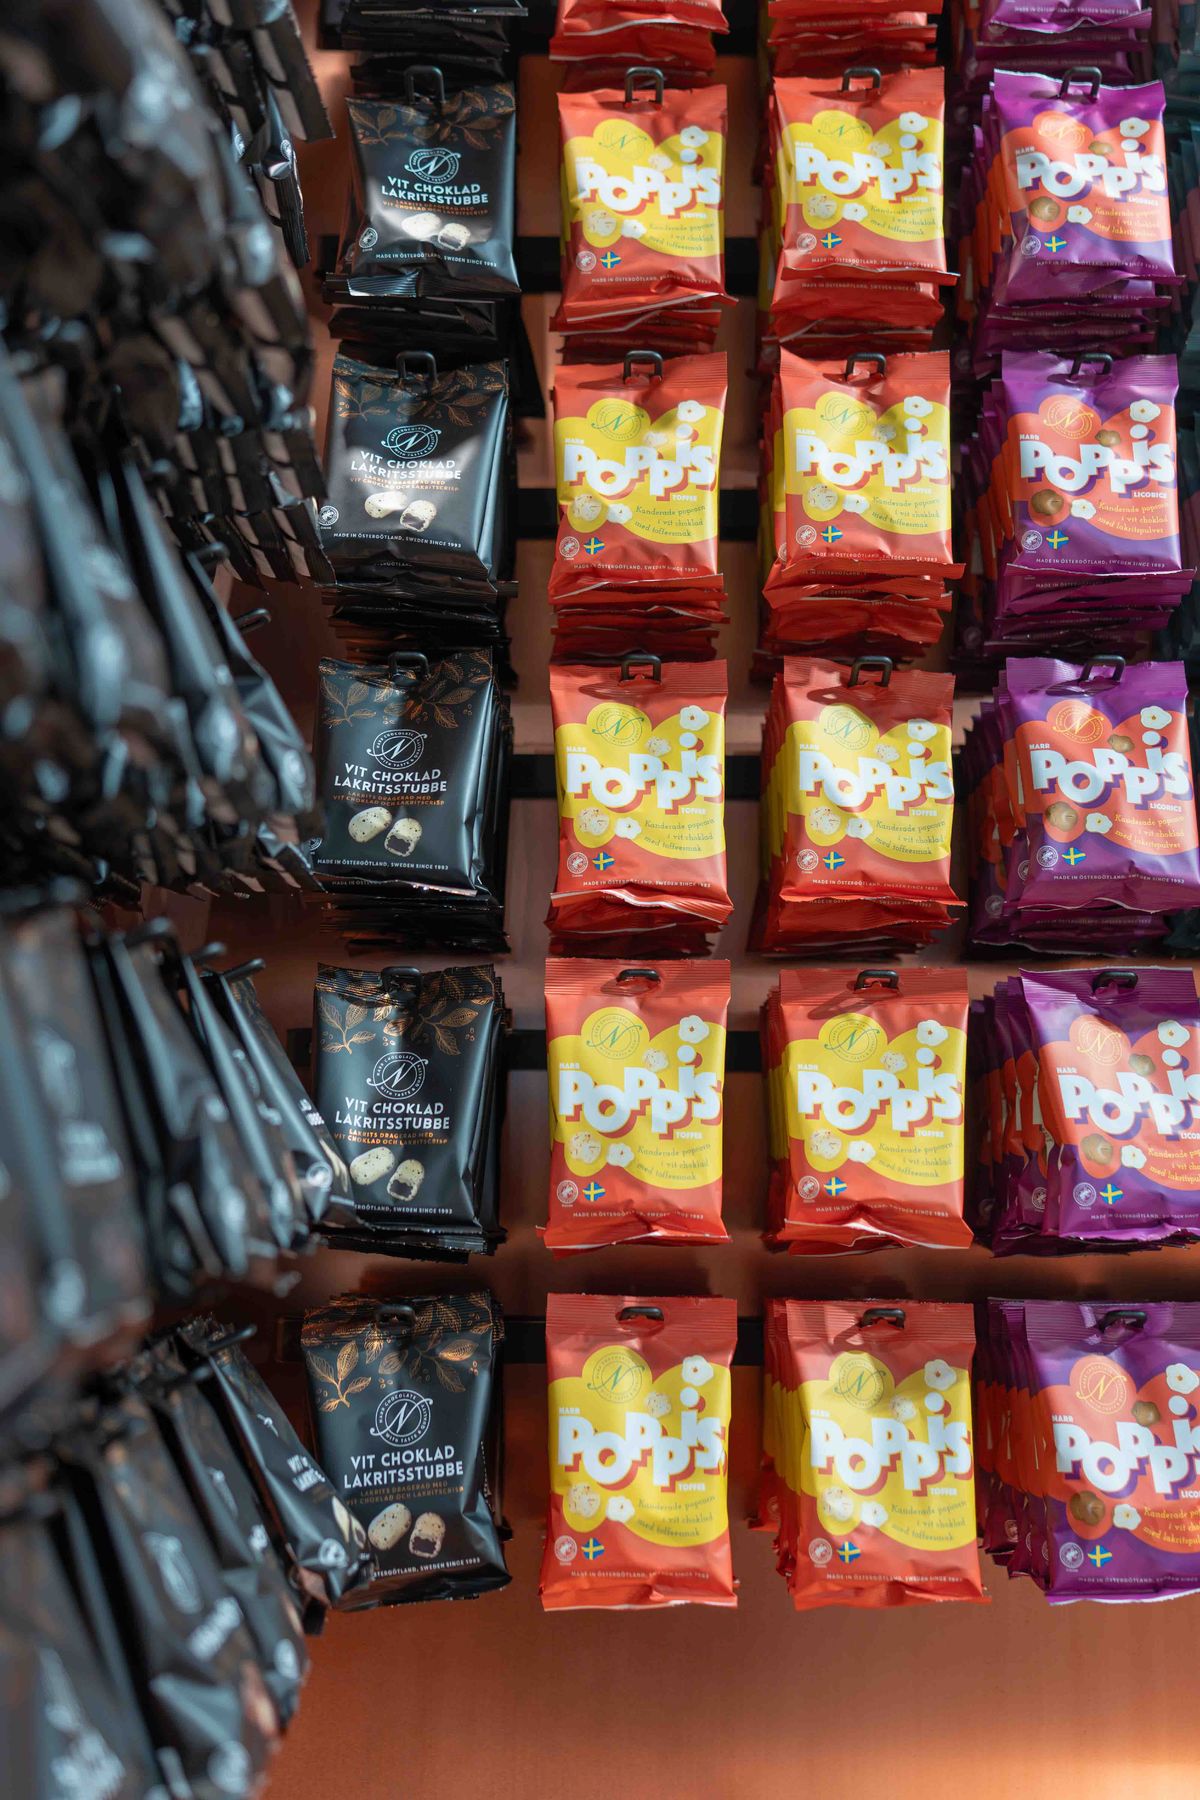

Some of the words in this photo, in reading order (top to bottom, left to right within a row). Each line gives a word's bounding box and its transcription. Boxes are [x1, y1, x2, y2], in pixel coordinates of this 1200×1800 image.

[387, 176, 409, 190] VIT
[413, 183, 481, 195] CHOKLAD
[381, 185, 489, 205] LAKRITSSTUBBE
[444, 255, 465, 263] SWEDEN
[361, 451, 383, 464] VIT
[387, 460, 455, 469] CHOKLAD
[351, 461, 462, 480] LAKRITSSTUBBE
[345, 763, 368, 777] VIT
[372, 769, 441, 782] CHOKLAD
[334, 776, 447, 794] LAKRITSSTUBBE
[345, 1097, 368, 1113] VIT
[373, 1103, 444, 1115] CHOKLAD
[335, 1110, 450, 1130] LAKRITSSTUBBE
[347, 1135, 381, 1145] CHOKLAD
[349, 1128, 378, 1138] LAKRITS
[350, 1454, 375, 1470] VIT
[381, 1445, 455, 1467] CHOKLAD
[344, 1460, 464, 1489] LAKRITSSTUBBE
[420, 1562, 445, 1571] SWEDEN
[446, 1559, 464, 1567] SINCE
